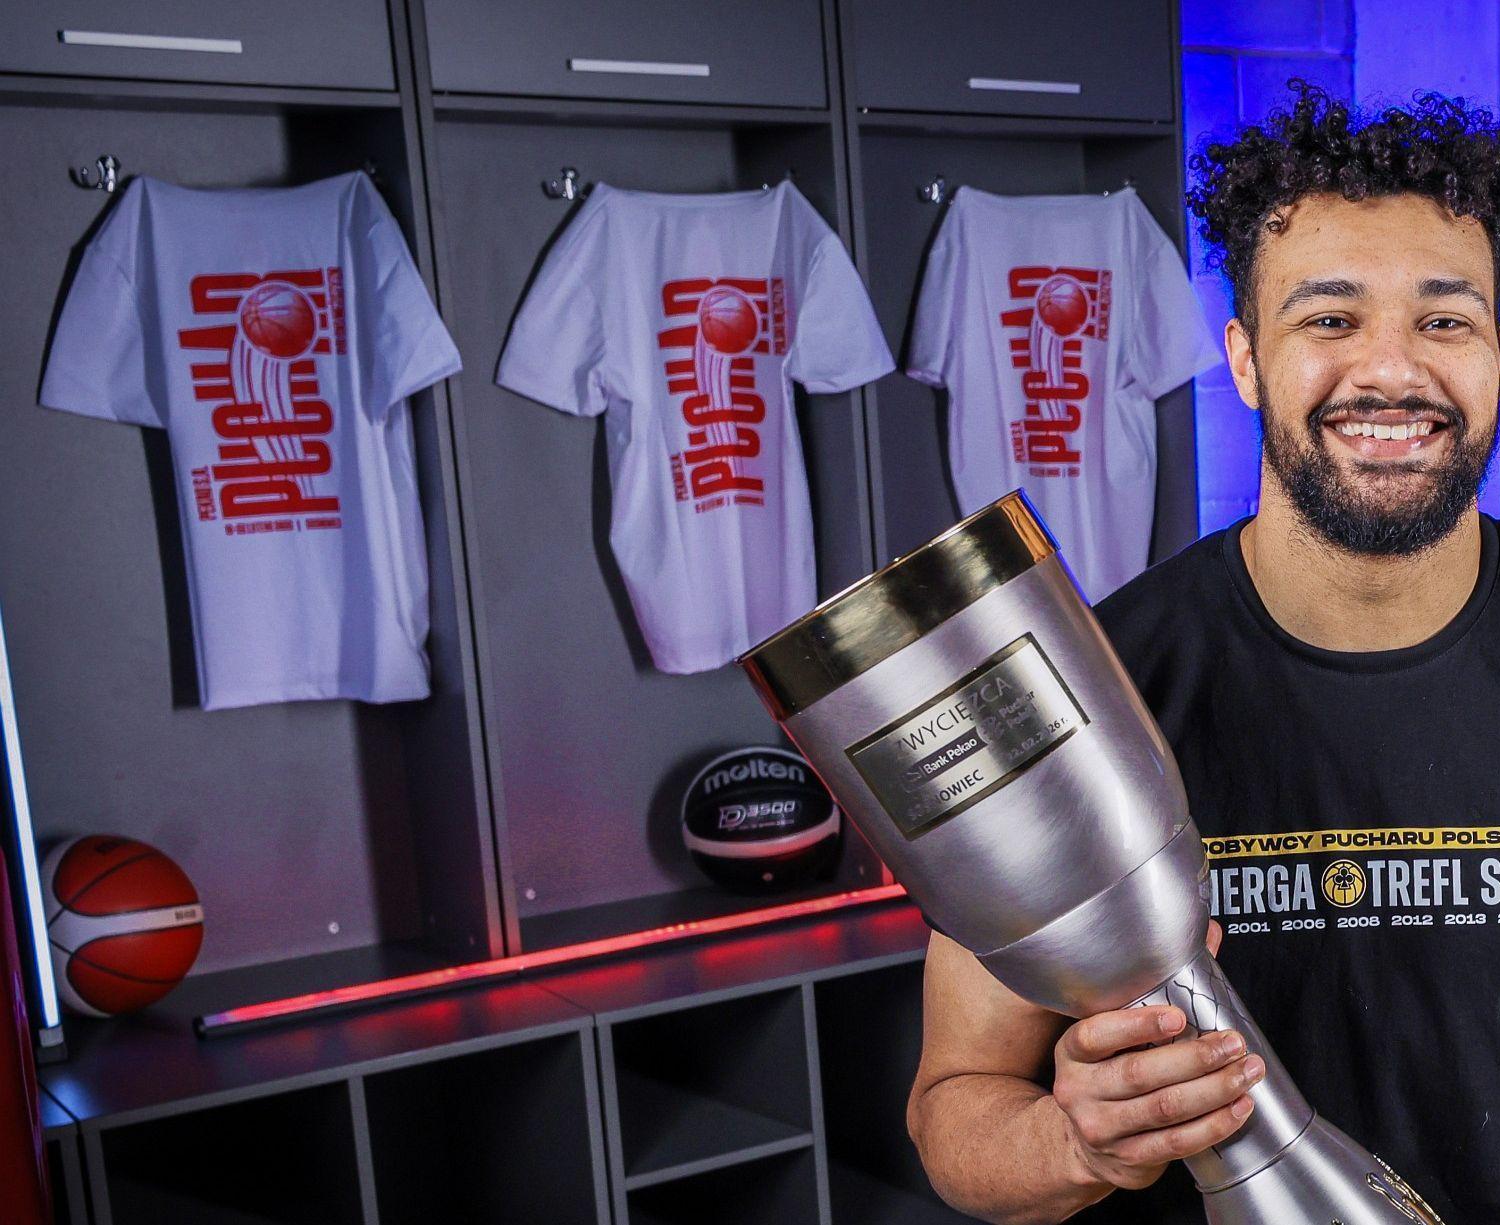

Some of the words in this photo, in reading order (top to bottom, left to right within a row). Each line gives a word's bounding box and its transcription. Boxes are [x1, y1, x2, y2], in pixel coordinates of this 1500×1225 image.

[922, 753, 949, 775] Bank
[946, 738, 978, 761] Pekao
[704, 758, 806, 794] molten
[1321, 831, 1435, 847] PUCHARU
[1367, 858, 1469, 907] TREFL
[1228, 922, 1270, 934] 2001
[1281, 919, 1326, 931] 2006
[1337, 916, 1380, 928] 2008
[1391, 914, 1433, 926] 2012
[1444, 913, 1487, 925] 2013
